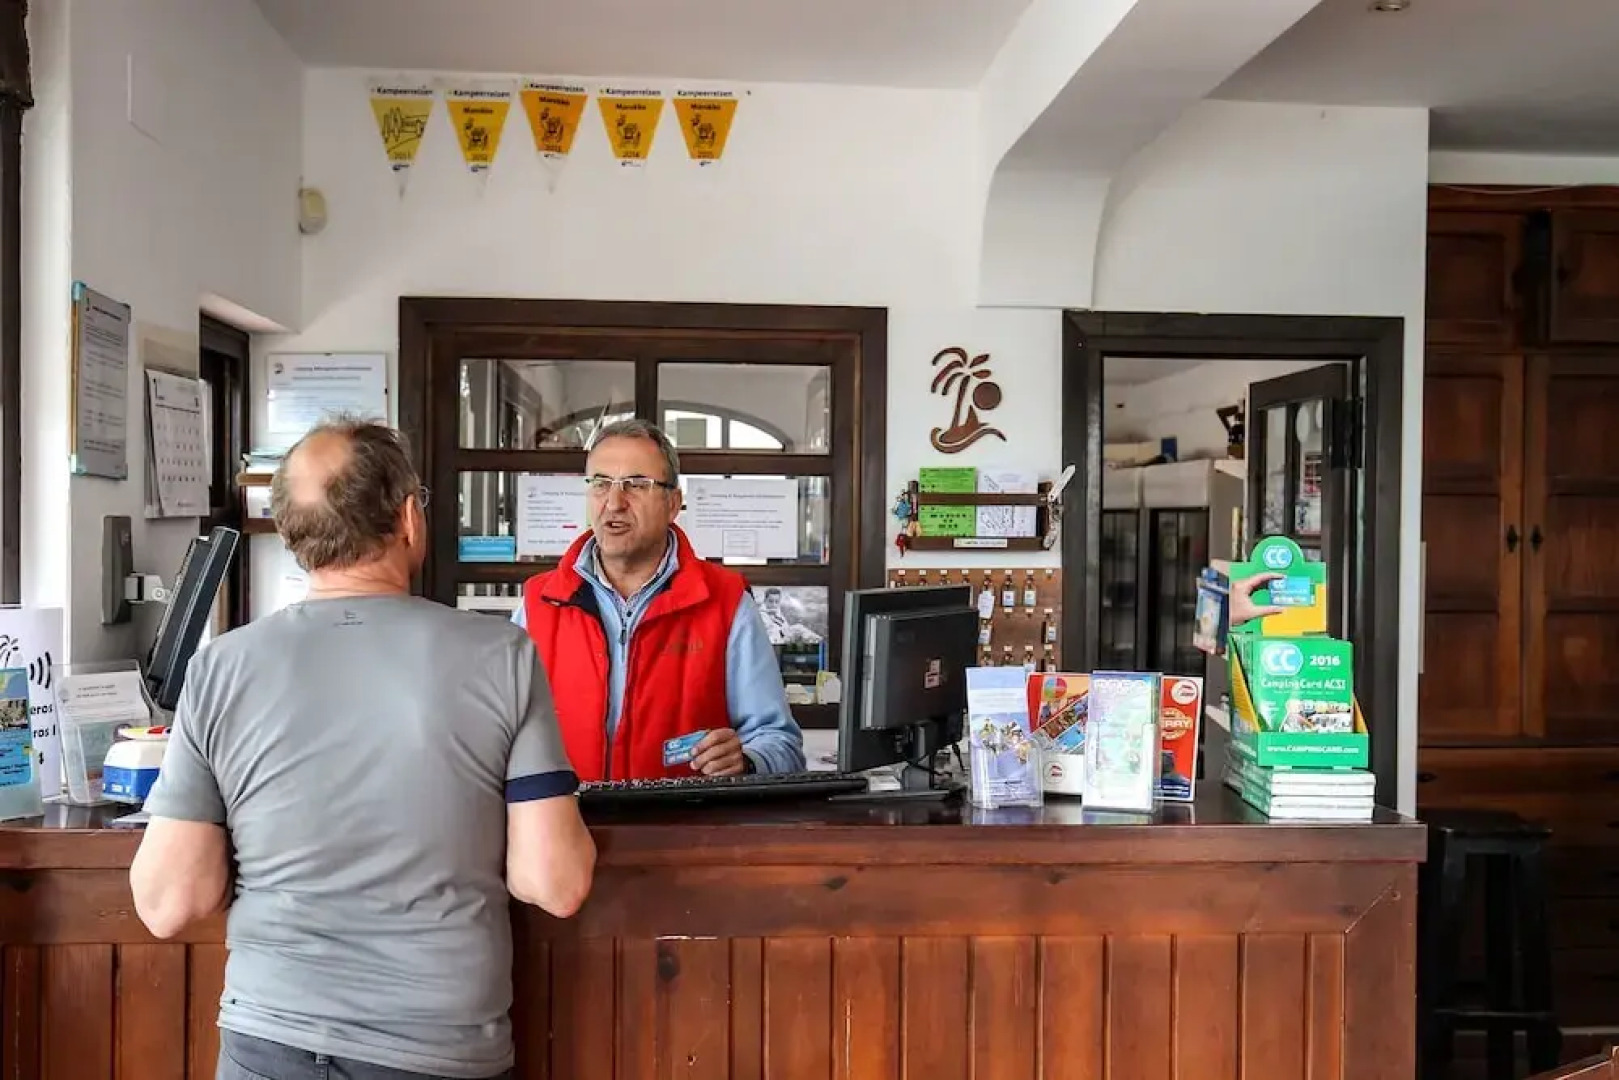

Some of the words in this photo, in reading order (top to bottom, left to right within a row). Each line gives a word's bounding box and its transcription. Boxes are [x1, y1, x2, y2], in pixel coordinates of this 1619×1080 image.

[1265, 548, 1290, 566] CC
[1264, 648, 1298, 672] CC
[1309, 655, 1341, 667] 2016
[1323, 678, 1347, 691] ACSI
